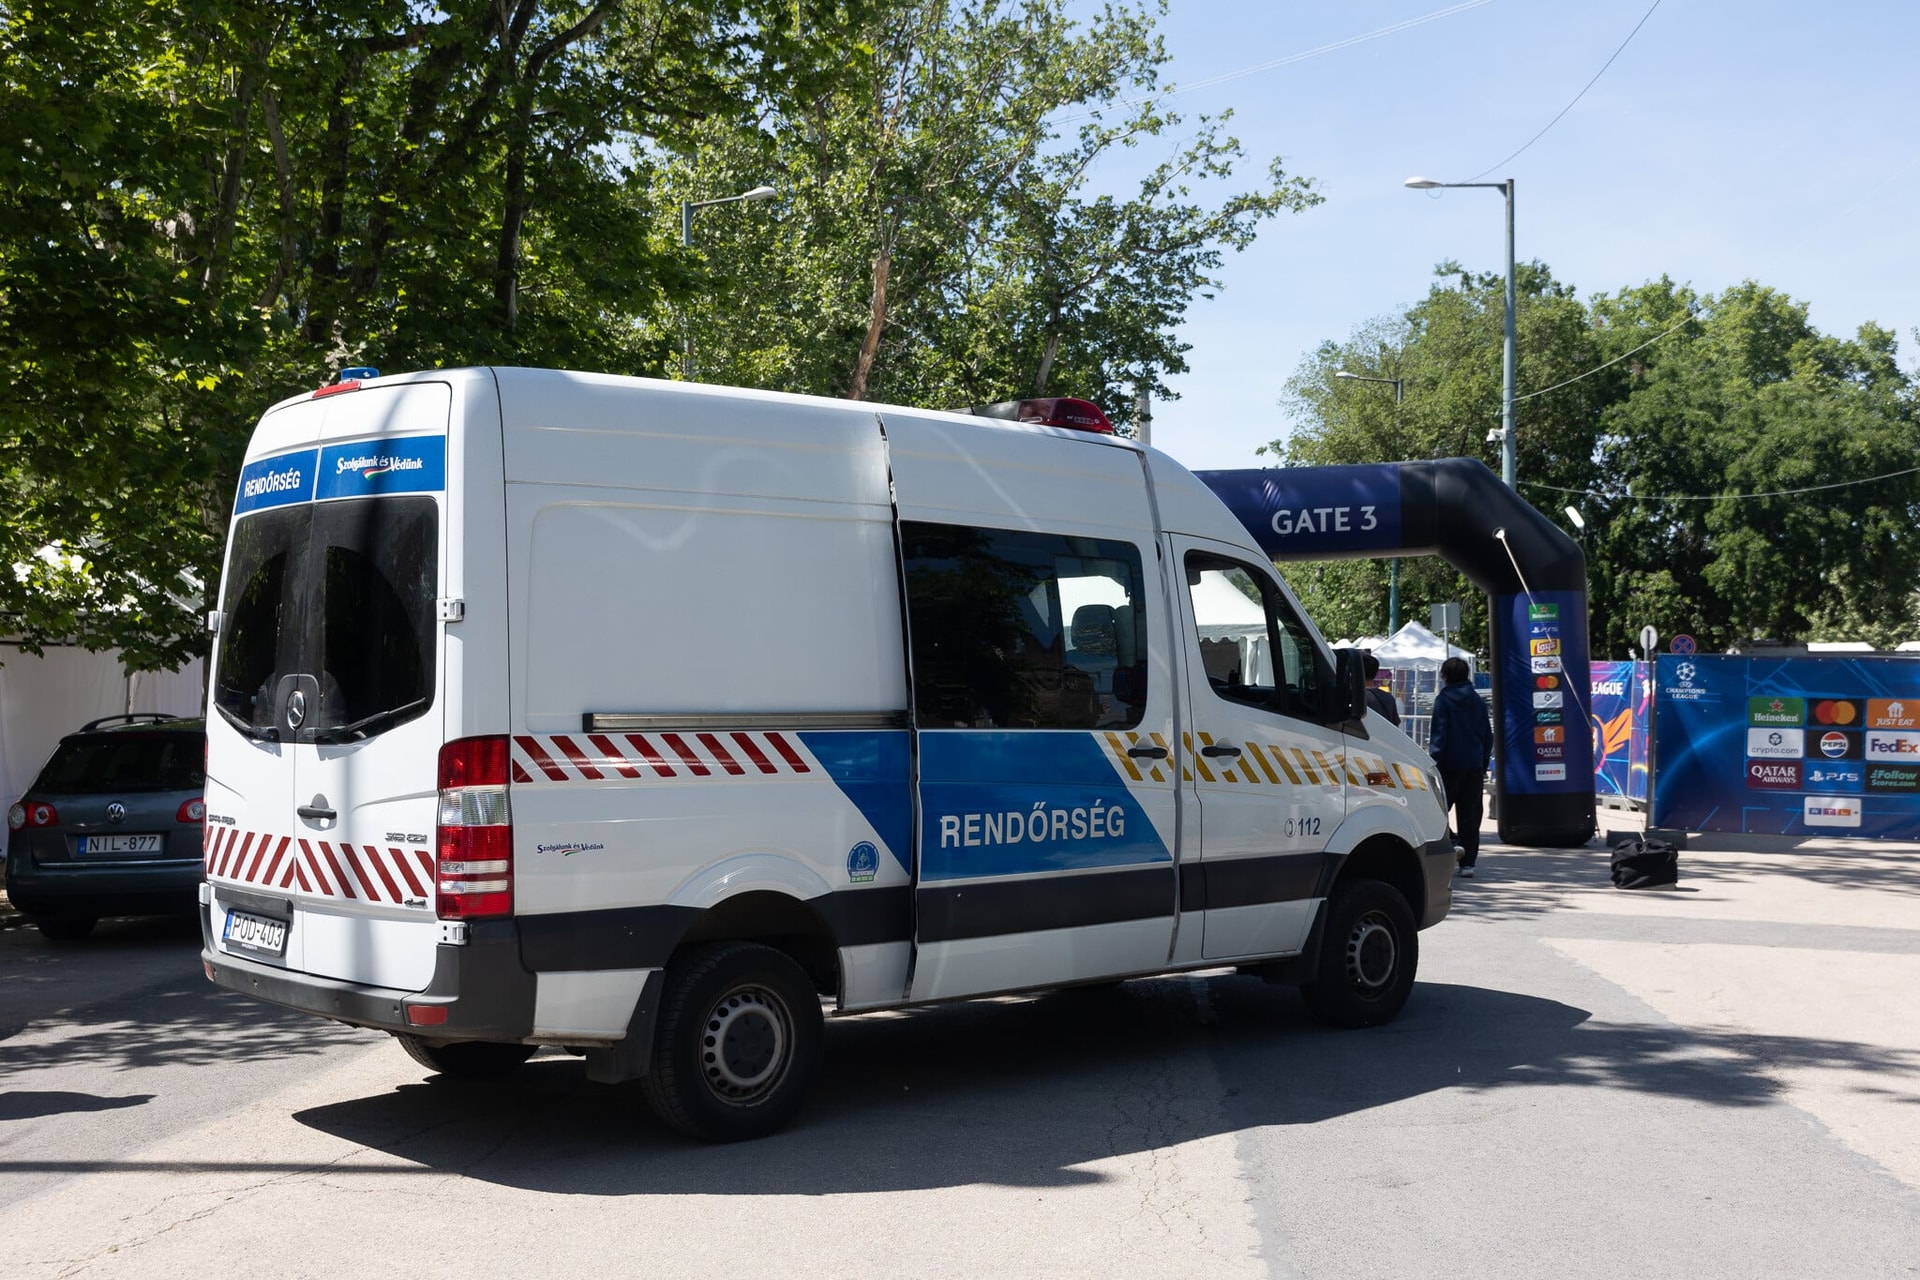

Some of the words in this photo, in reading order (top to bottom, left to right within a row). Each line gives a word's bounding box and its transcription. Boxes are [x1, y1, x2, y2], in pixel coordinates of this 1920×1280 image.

[336, 456, 378, 474] Szolgálunk
[379, 455, 389, 467] és
[389, 456, 423, 472] Védünk
[244, 469, 301, 498] RENDŐRSÉG
[1271, 506, 1351, 535] GATE
[1360, 505, 1377, 531] 3
[1534, 660, 1559, 669] FedEx
[1665, 687, 1706, 695] CHAMPIONS
[1754, 713, 1799, 722] Heineken
[1876, 718, 1896, 726] JUST
[1898, 718, 1915, 726] EAT
[1537, 747, 1562, 755] QATAR
[1751, 746, 1799, 755] crypto.com
[1871, 738, 1918, 754] FedEx
[1751, 765, 1796, 778] QATAR
[1826, 772, 1859, 782] PS5
[1762, 776, 1796, 784] AIRWAYS
[940, 799, 1125, 848] RENDŐRSÉG
[1298, 817, 1320, 836] 112
[89, 836, 157, 851] NIL-877
[232, 914, 283, 947] POD-403
